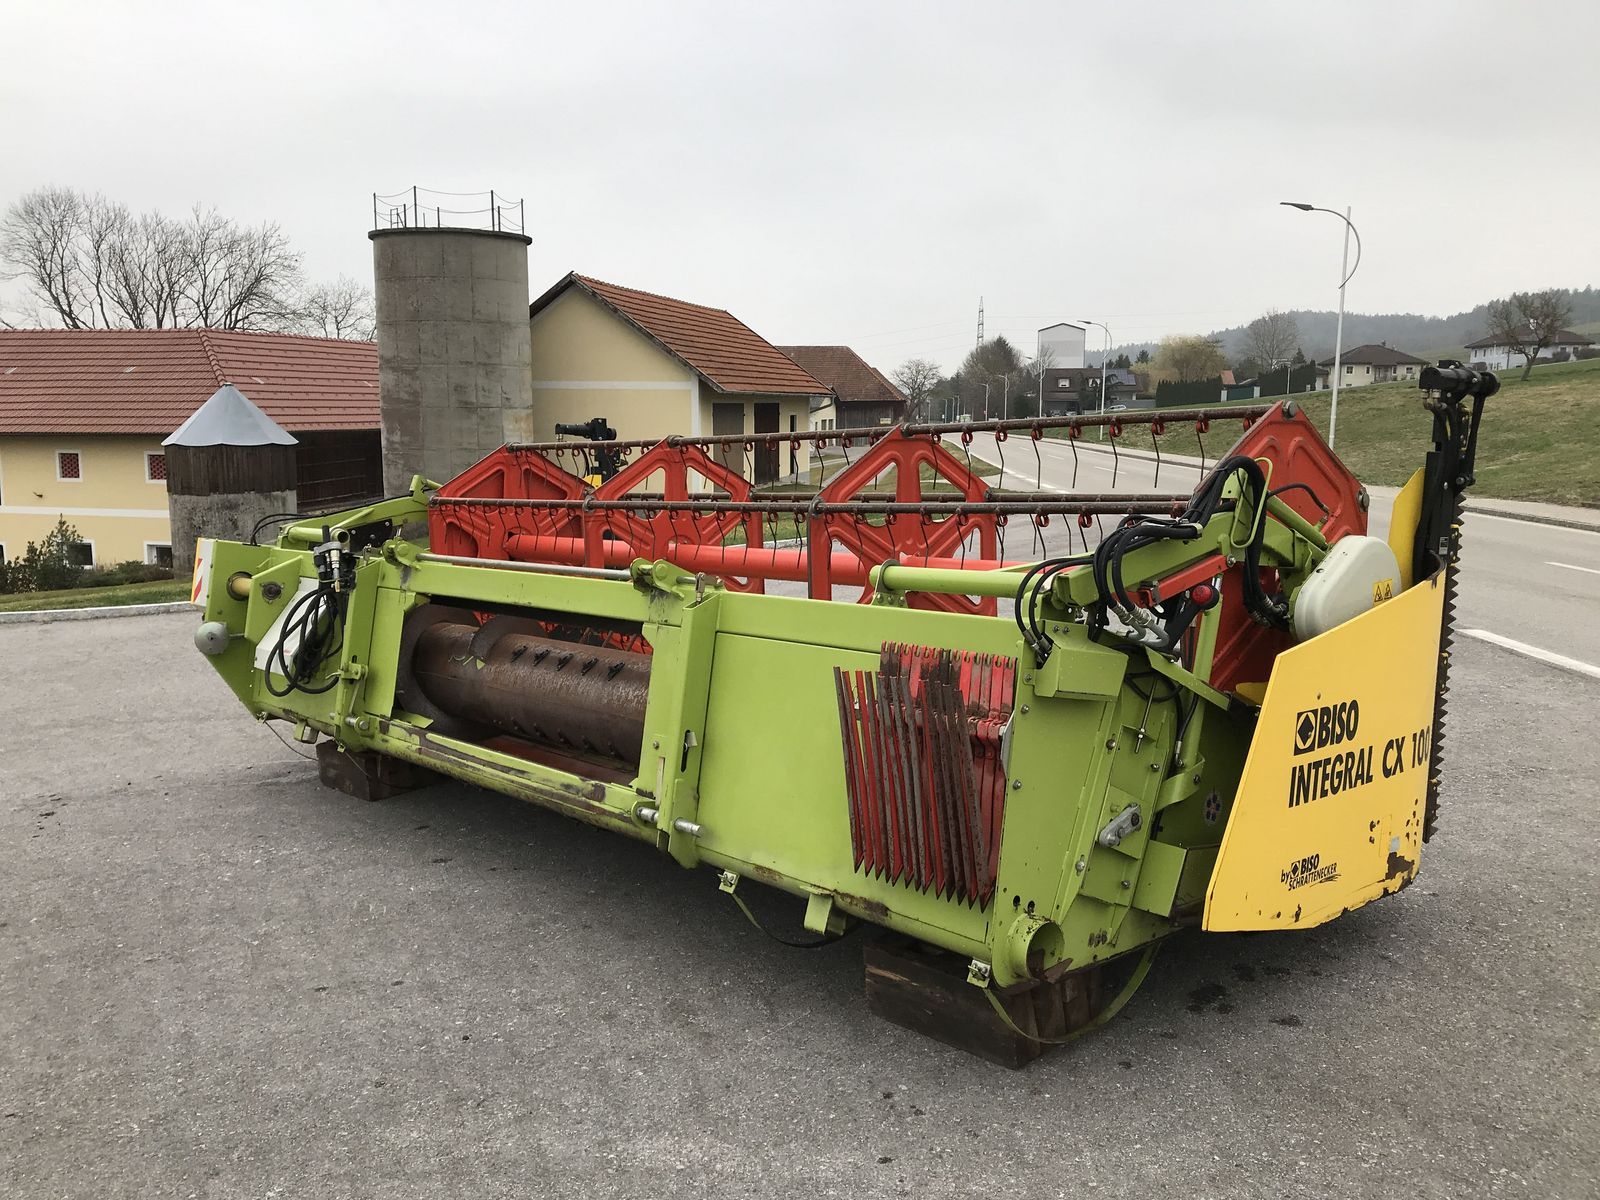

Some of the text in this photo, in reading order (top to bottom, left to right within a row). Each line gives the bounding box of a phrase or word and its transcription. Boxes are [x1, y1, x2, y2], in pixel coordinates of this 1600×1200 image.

[1317, 699, 1359, 748] BISO
[1288, 745, 1374, 808] INTEGRAL
[1382, 736, 1406, 778] CX
[1280, 853, 1320, 885] by BISO
[1288, 862, 1338, 891] SCHRATTENECKER
